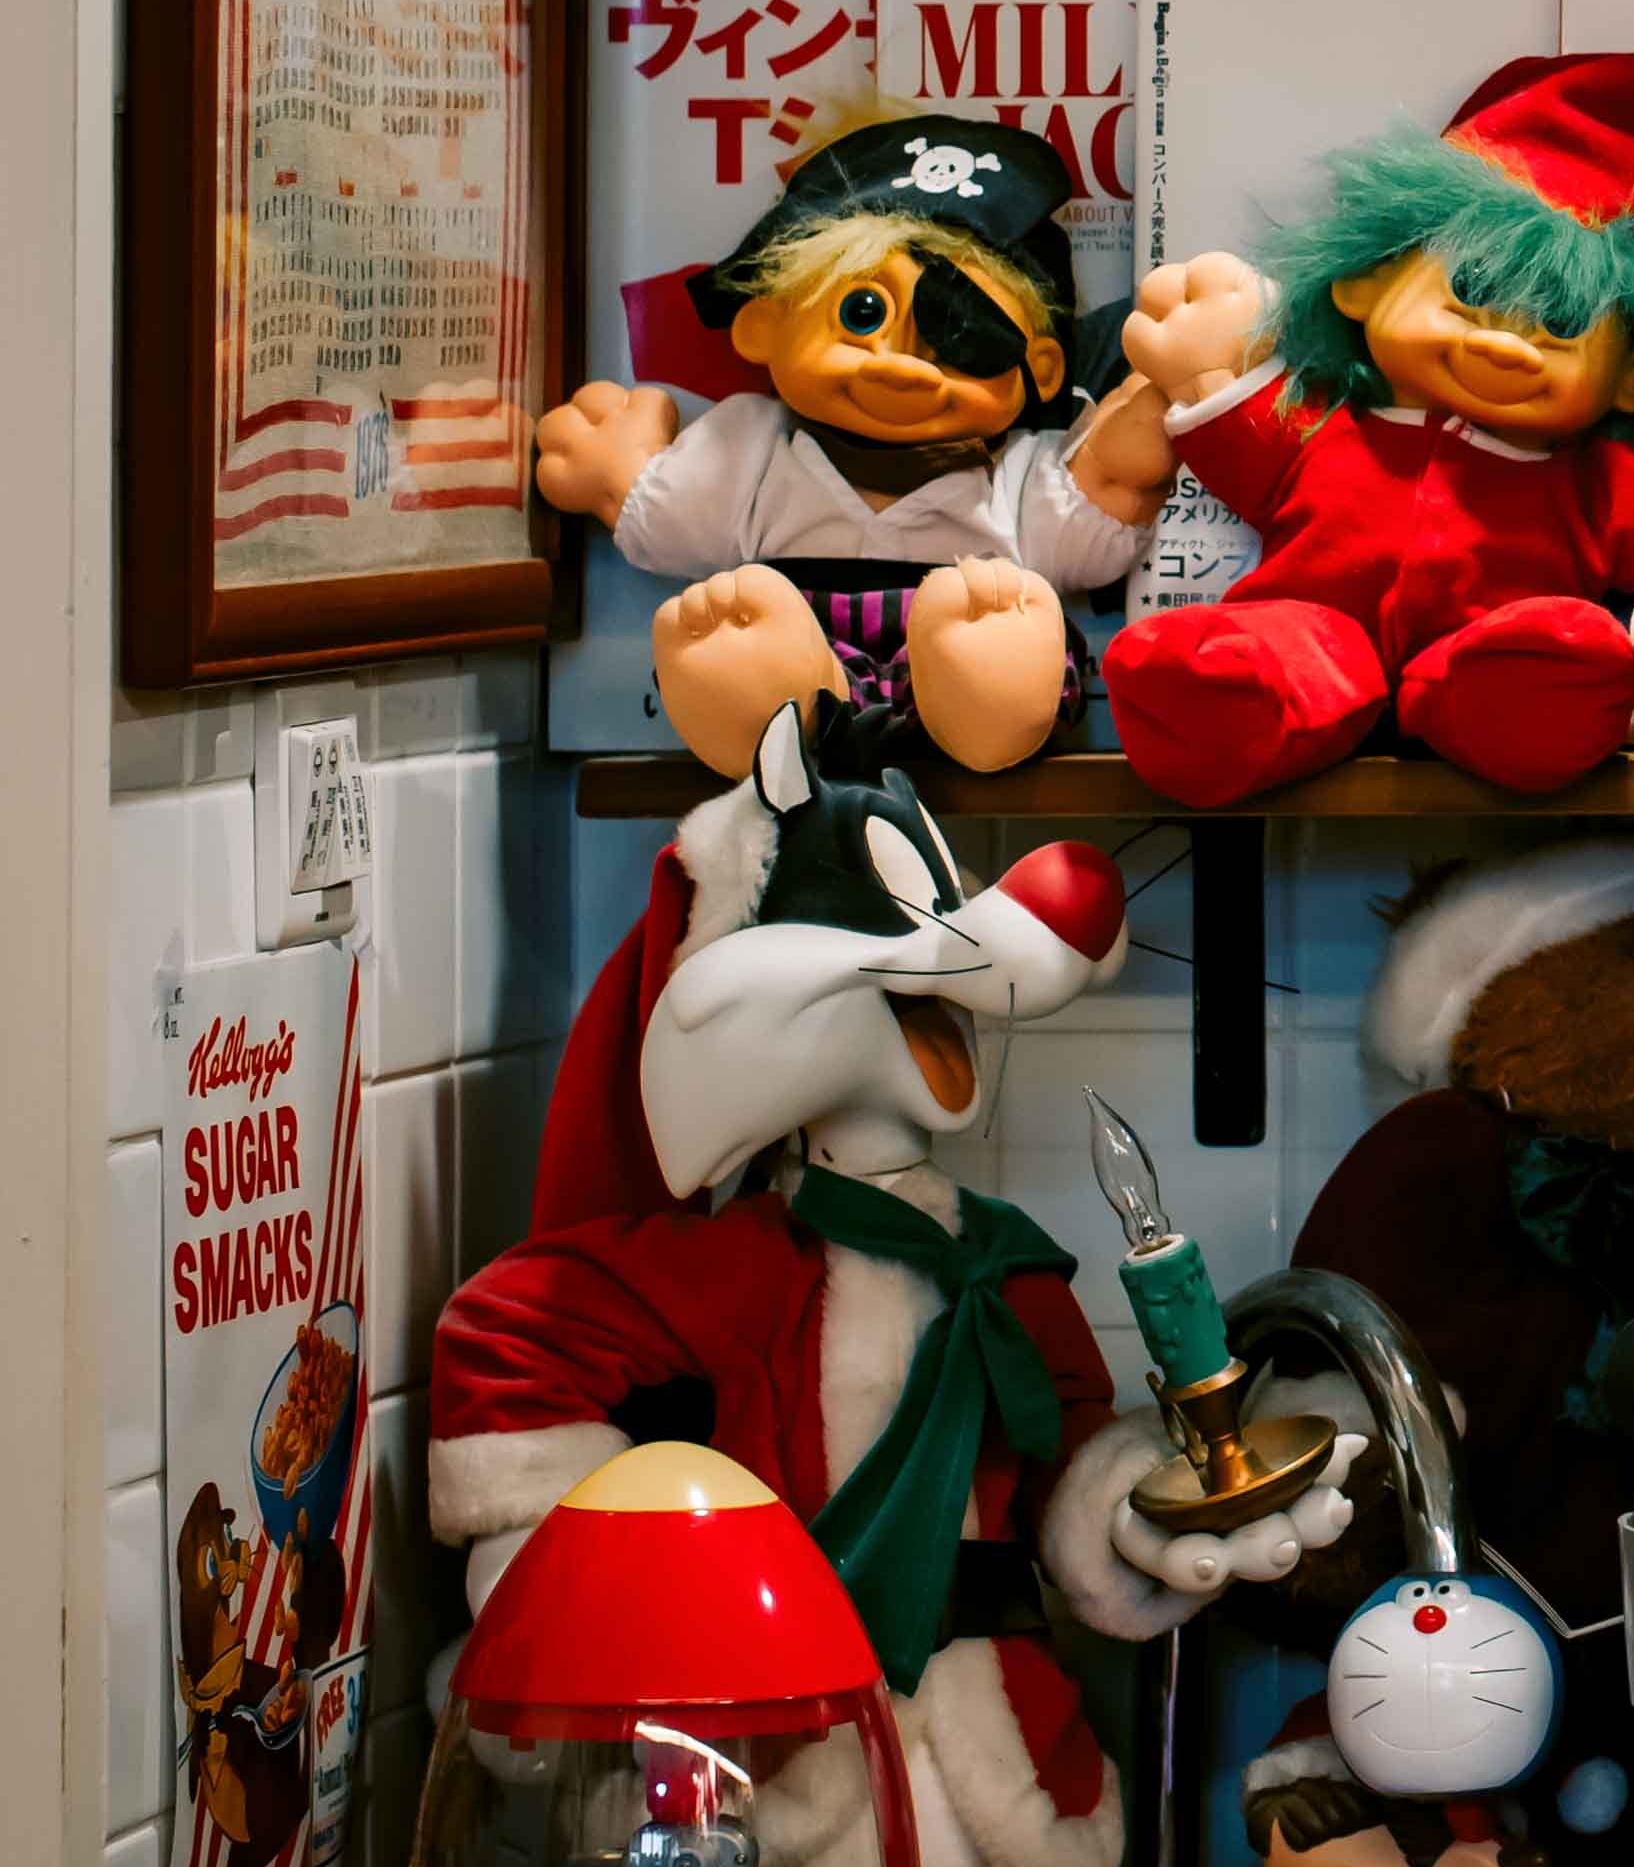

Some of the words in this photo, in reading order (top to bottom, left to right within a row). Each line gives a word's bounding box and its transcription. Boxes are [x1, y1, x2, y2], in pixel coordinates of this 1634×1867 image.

[915, 2, 1135, 99] MIL
[187, 1013, 296, 1102] Kellogg's
[184, 1104, 300, 1219] SUGAR
[173, 1207, 314, 1335] SMACKS
